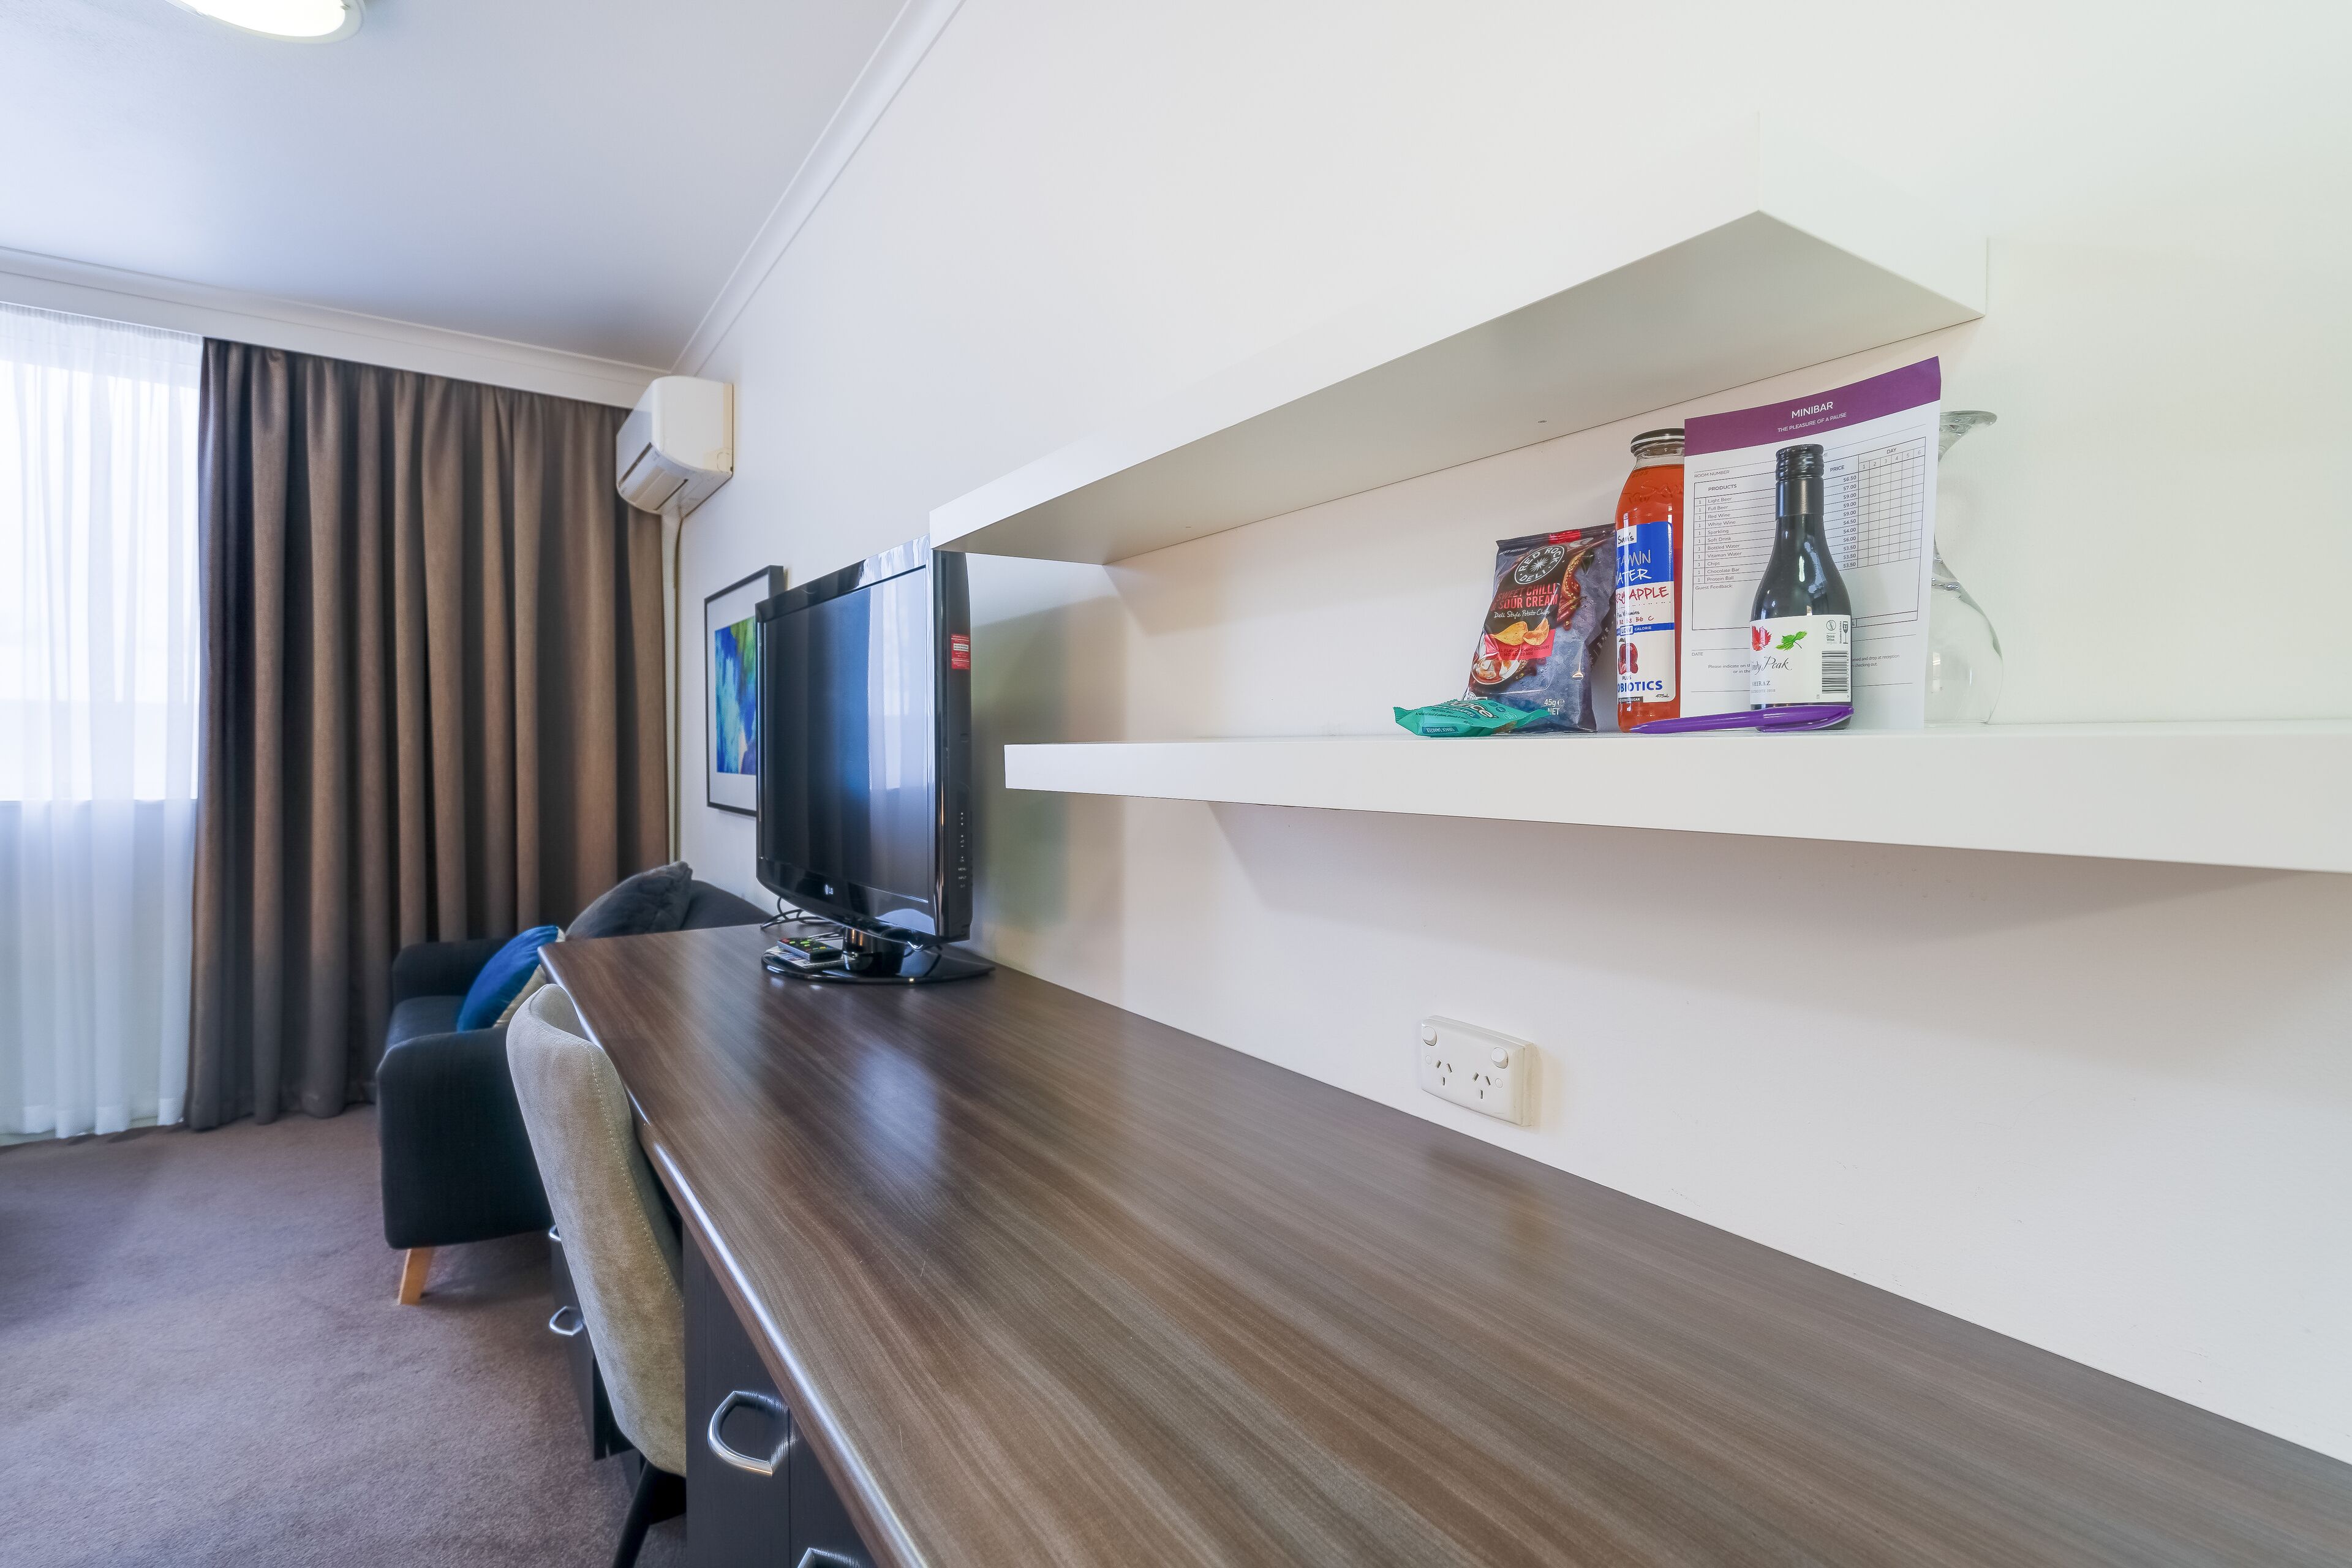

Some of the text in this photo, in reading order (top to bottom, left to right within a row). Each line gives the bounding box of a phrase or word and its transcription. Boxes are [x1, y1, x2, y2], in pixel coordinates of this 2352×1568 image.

[1792, 401, 1833, 418] MINIBAR
[1789, 420, 1816, 431] PLEASURE
[1830, 412, 1847, 422] PAUSE
[1518, 547, 1561, 572] RED ROCK
[1616, 549, 1651, 569] TAMIN
[1518, 569, 1547, 582] DELI
[1616, 568, 1653, 586] ATER
[1497, 583, 1556, 601] SWEET CHILLI
[1629, 586, 1669, 601] APPLE
[1499, 597, 1523, 609] SOUR
[1526, 594, 1558, 608] CREAM
[1507, 611, 1521, 619] Style
[1762, 655, 1793, 672] Peak
[1617, 680, 1663, 693] OBIOTICS
[1544, 698, 1556, 707] 45g
